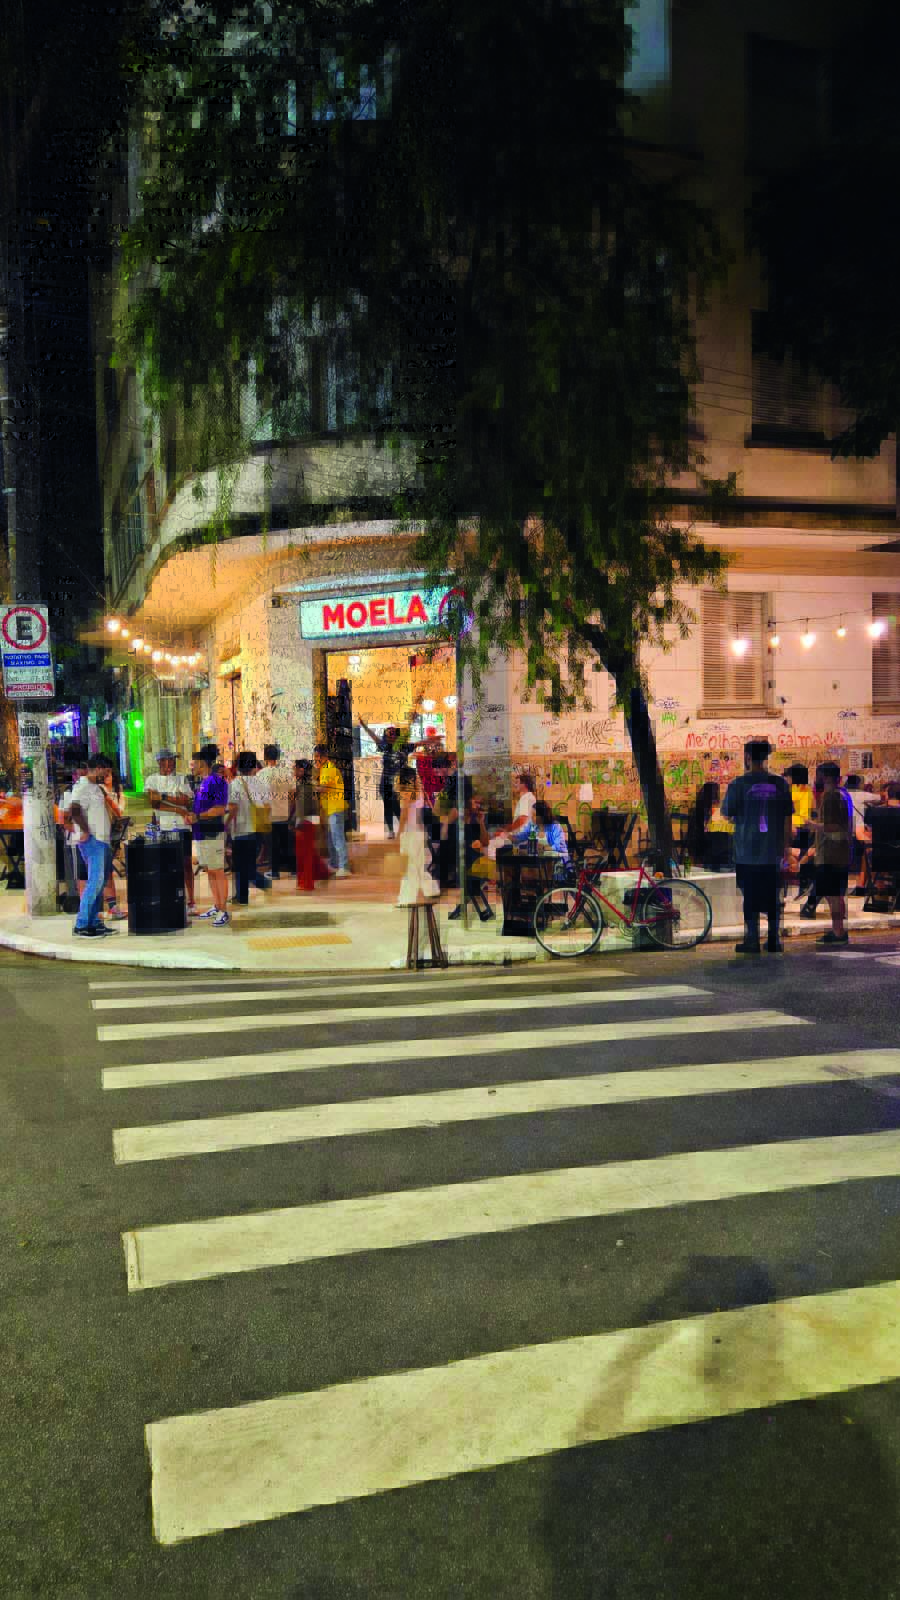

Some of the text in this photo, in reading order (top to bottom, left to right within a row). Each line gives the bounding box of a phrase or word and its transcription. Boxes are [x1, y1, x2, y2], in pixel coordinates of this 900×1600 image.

[321, 594, 429, 631] MOELA
[15, 615, 33, 641] E
[685, 733, 703, 749] Me
[778, 728, 823, 746] calma
